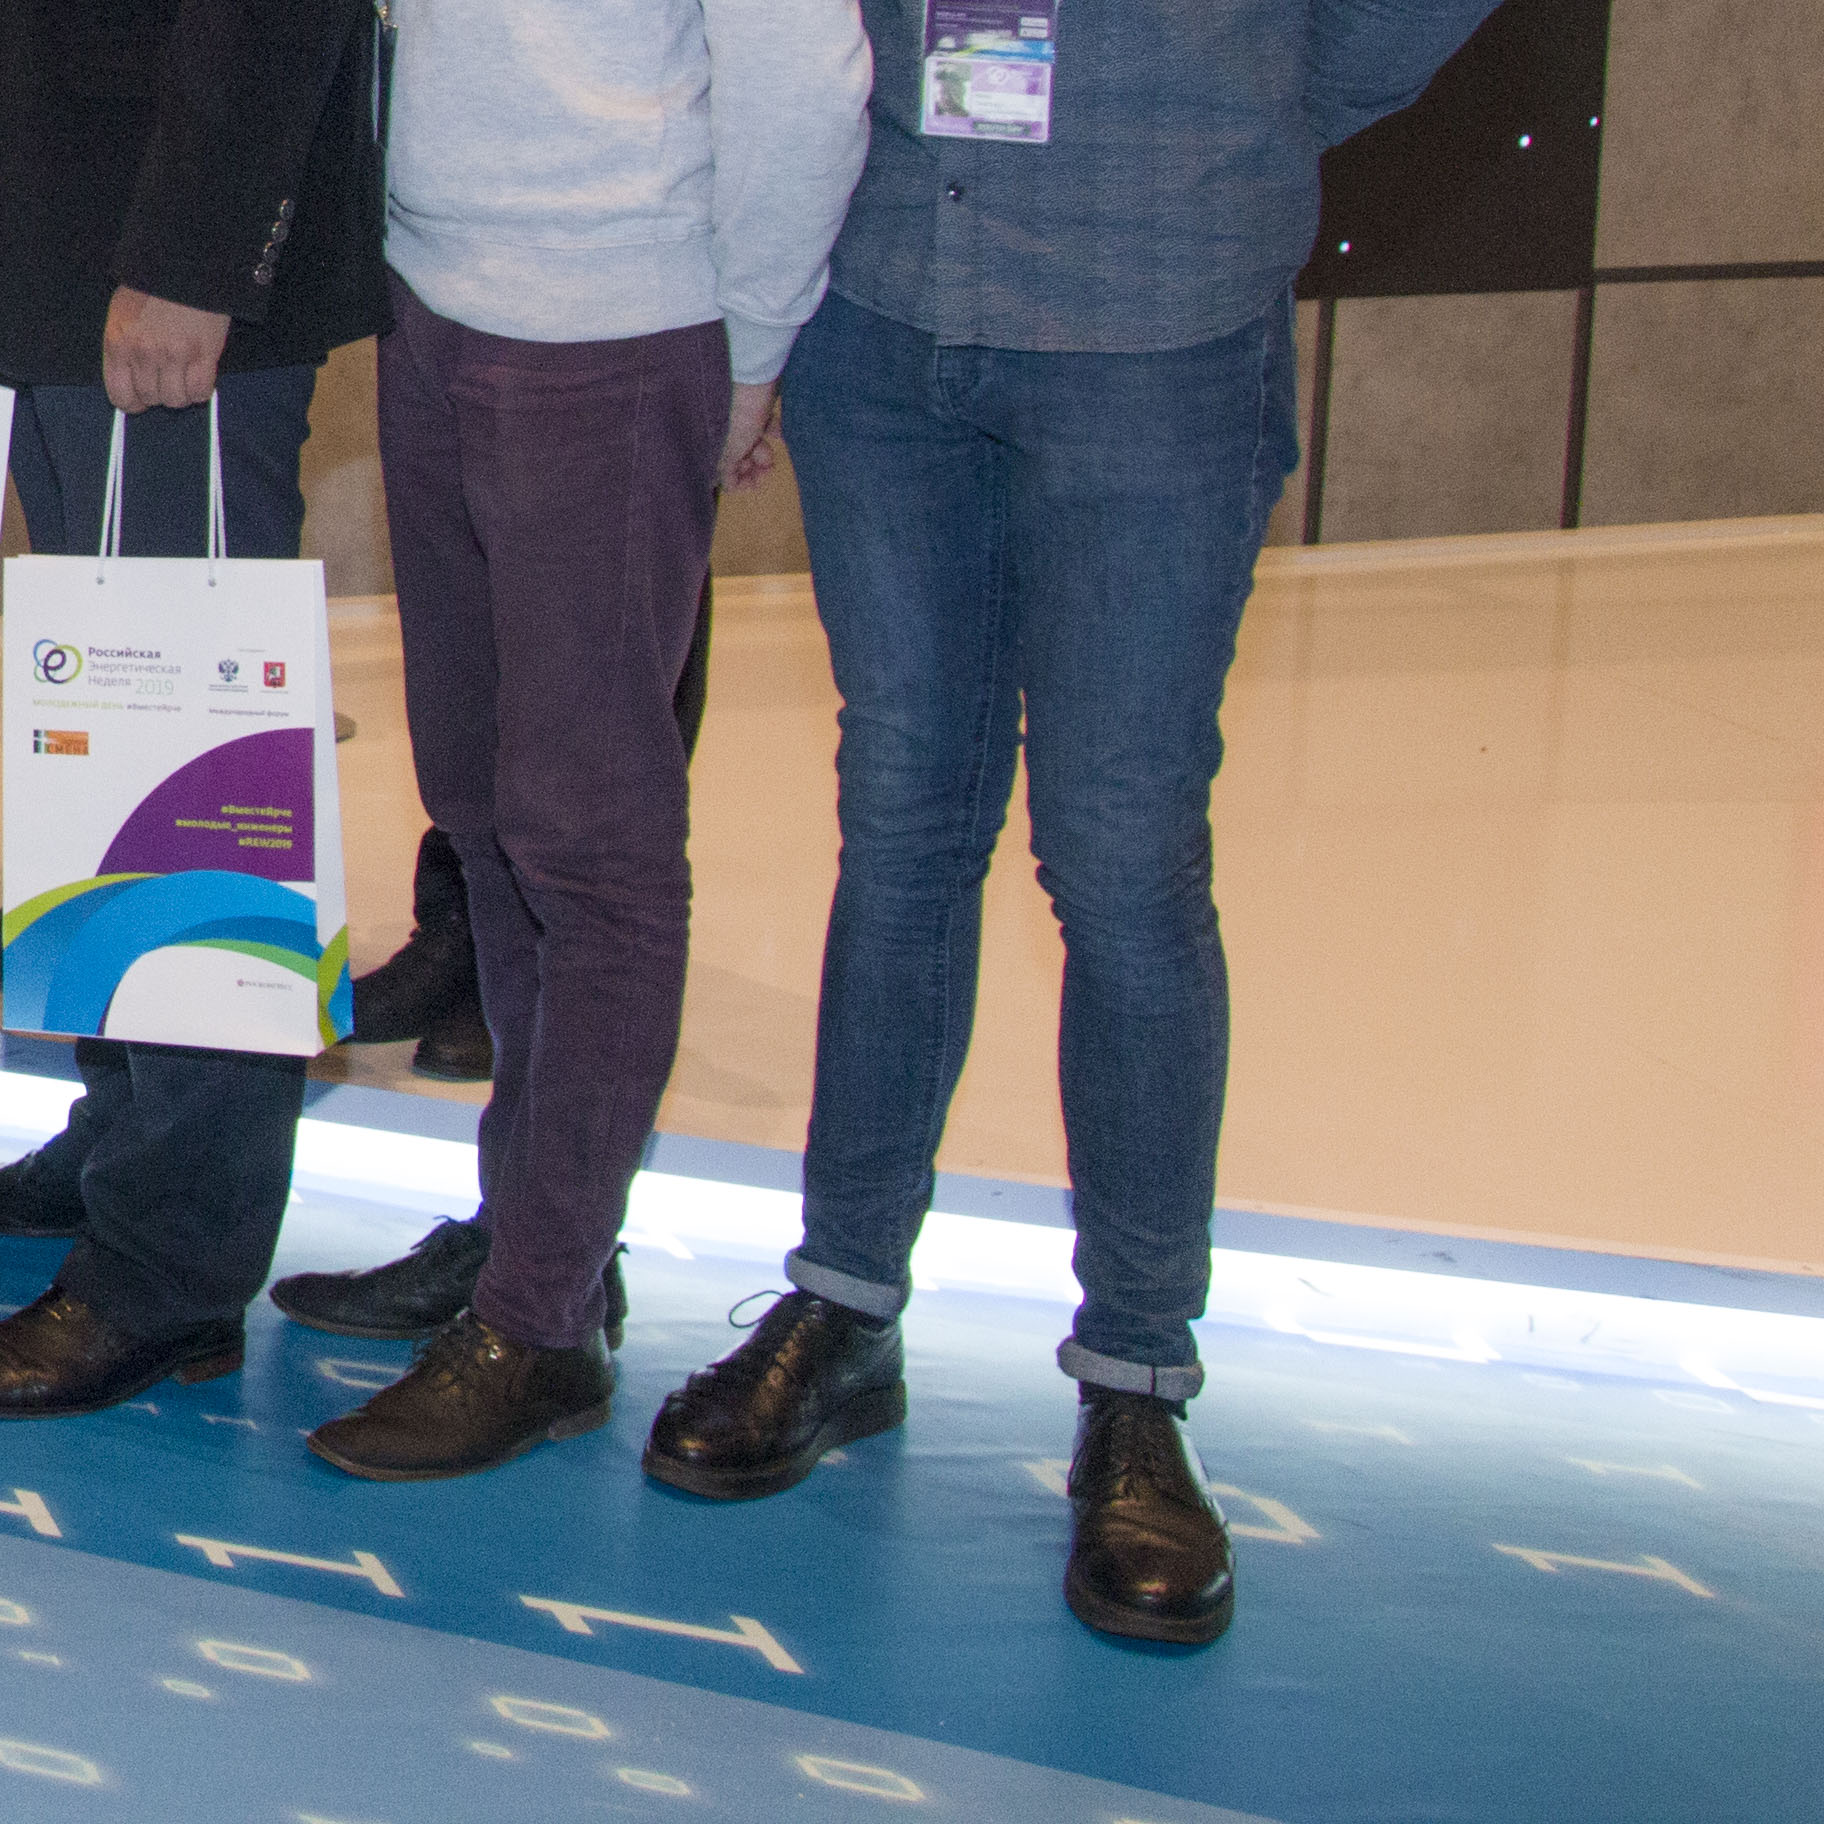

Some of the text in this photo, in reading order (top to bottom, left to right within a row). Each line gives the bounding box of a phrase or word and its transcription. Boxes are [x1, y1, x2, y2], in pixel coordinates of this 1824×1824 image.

[88, 646, 162, 660] Российская
[87, 660, 183, 675] Энергетическая
[87, 675, 175, 696] Неделя 2019
